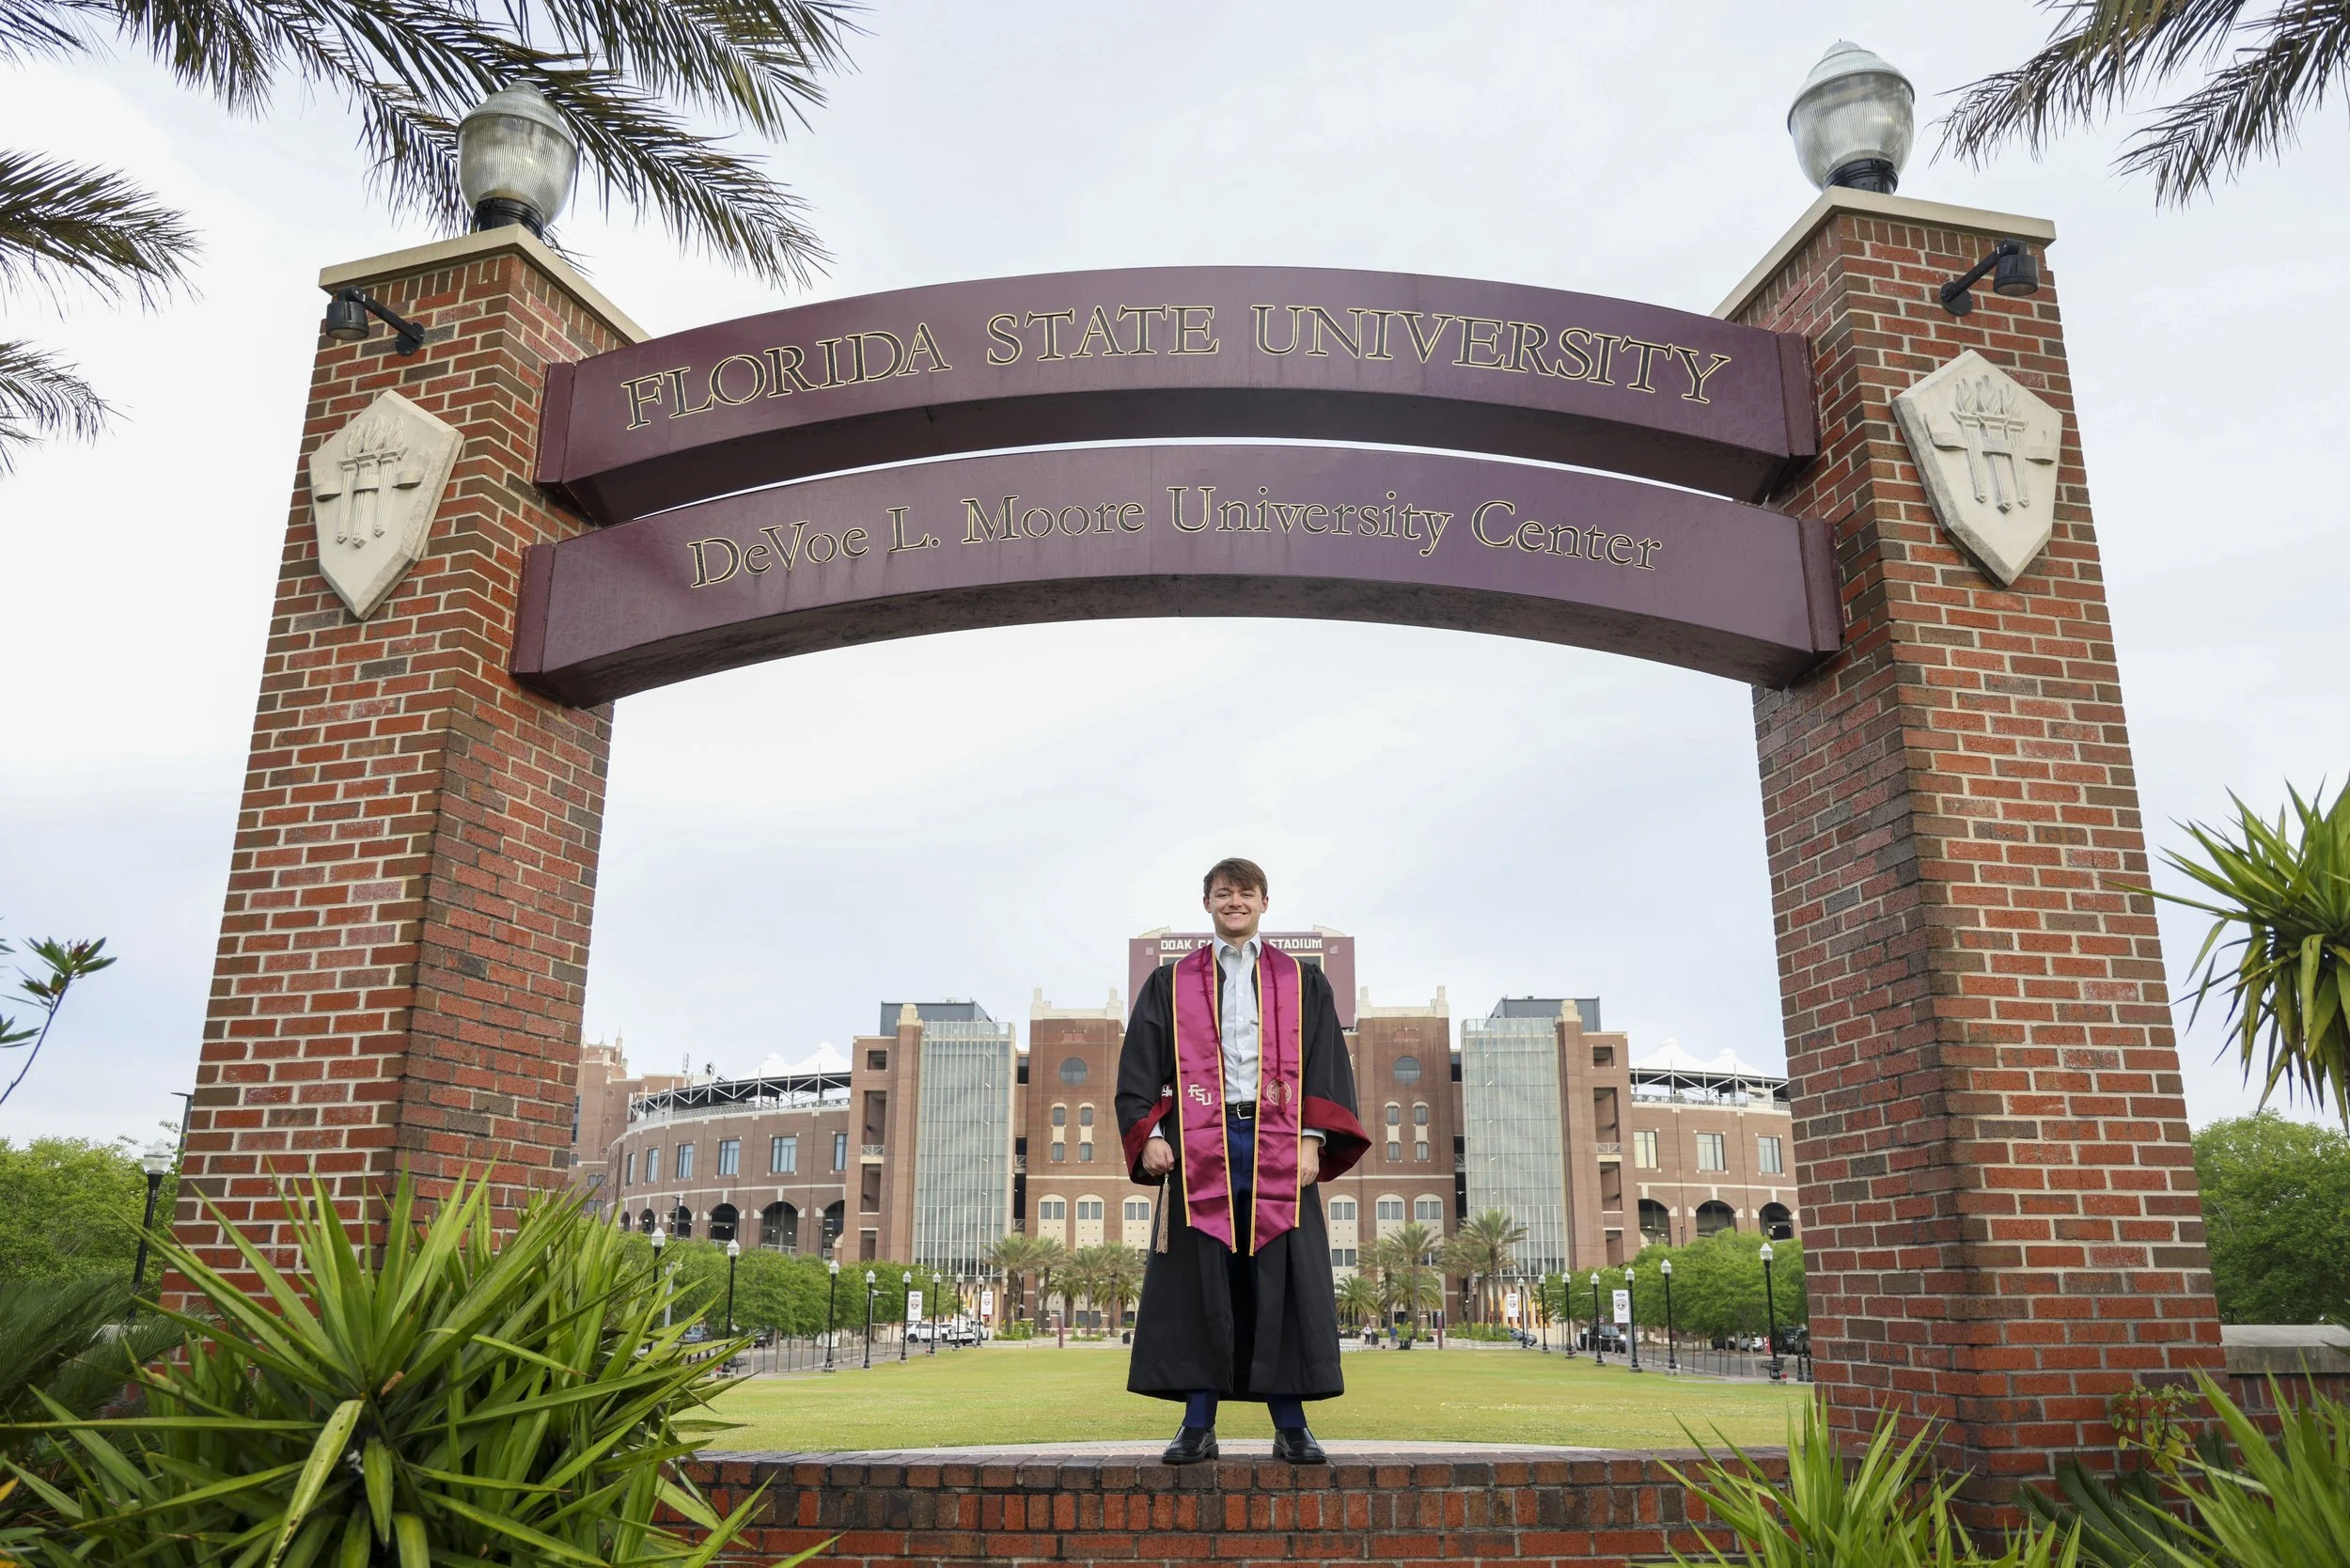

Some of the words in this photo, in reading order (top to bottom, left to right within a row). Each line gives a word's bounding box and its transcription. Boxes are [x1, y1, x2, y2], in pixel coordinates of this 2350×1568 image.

[620, 322, 952, 431] FLORIDA
[986, 305, 1219, 364] STATE
[1251, 304, 1731, 404] UNIVERSITY
[687, 520, 870, 588] DeVoe
[885, 505, 941, 553] L.
[961, 494, 1145, 544] Moore
[1167, 486, 1453, 557] University
[1471, 499, 1663, 571] Center
[1161, 939, 1193, 950] DOAK
[1269, 938, 1323, 949] STADIUM
[1187, 1084, 1214, 1106] FSU
